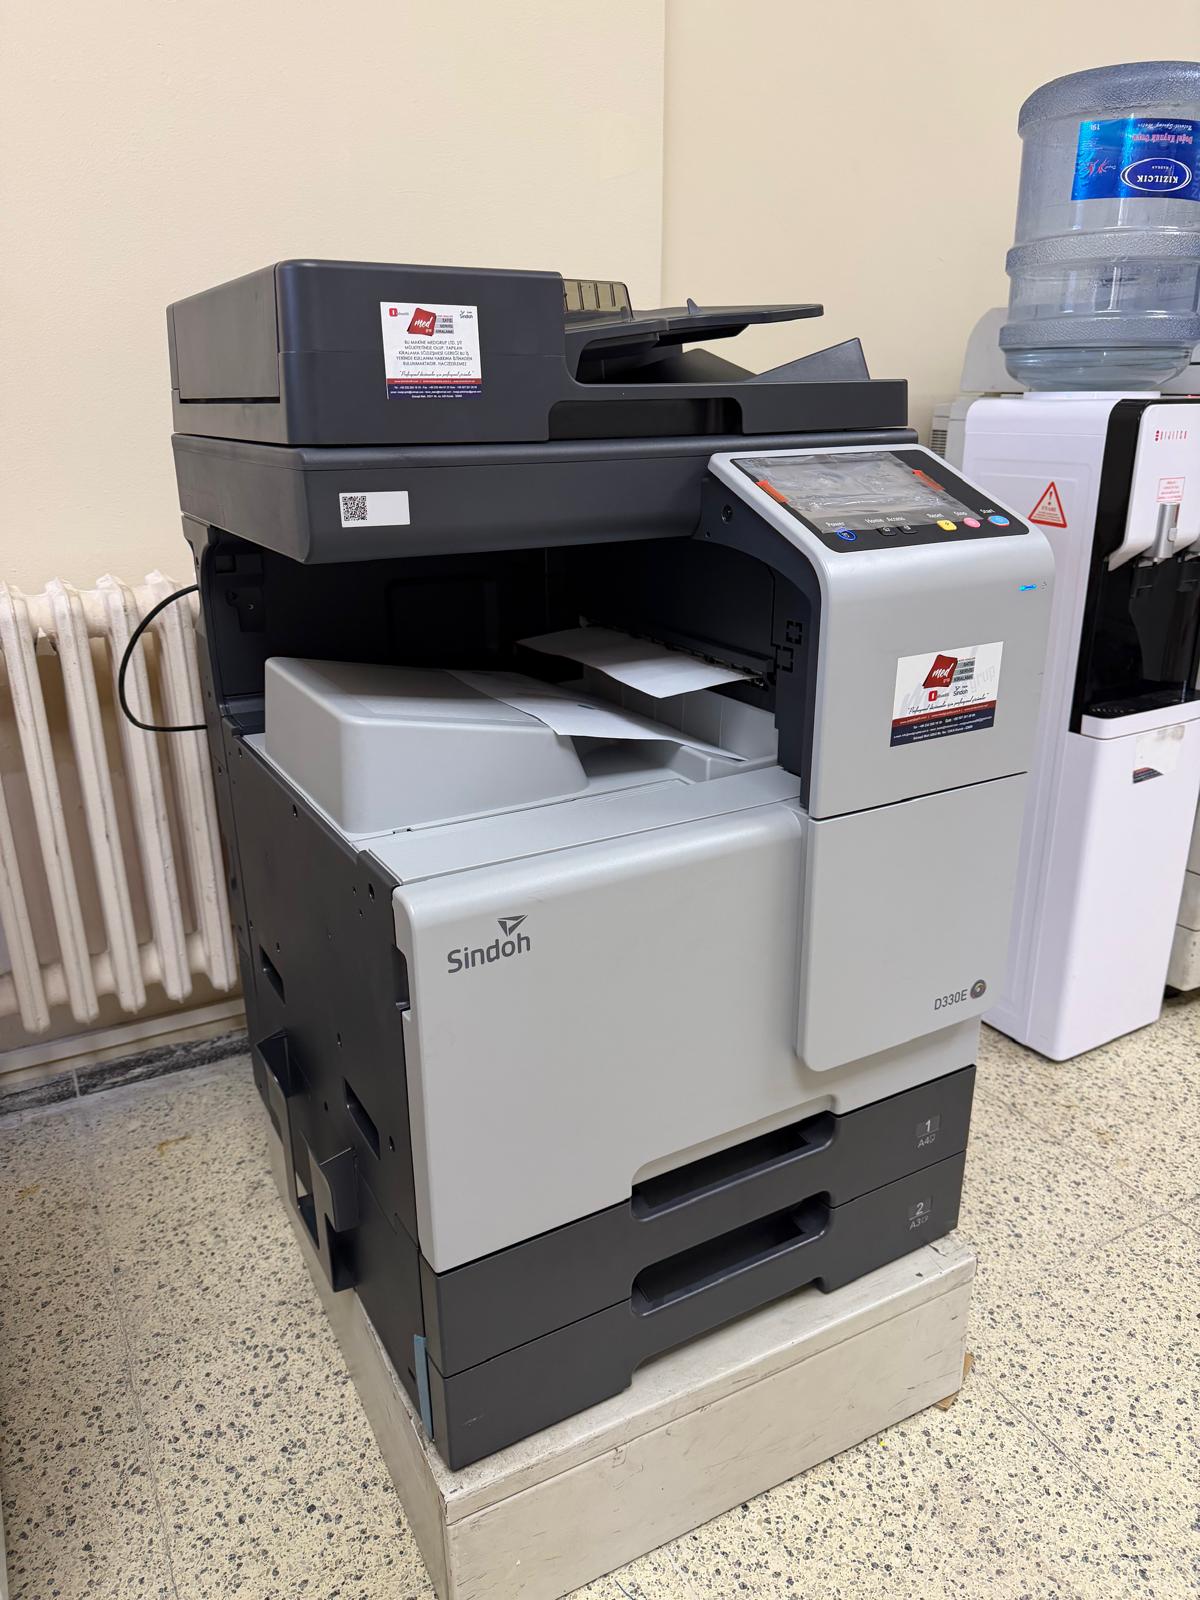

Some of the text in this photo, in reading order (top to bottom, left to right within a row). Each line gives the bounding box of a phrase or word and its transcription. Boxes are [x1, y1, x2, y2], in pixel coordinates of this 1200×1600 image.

[1137, 175, 1178, 184] KIZILCIK
[413, 316, 433, 329] med
[931, 662, 954, 678] med
[447, 933, 530, 974] Sindoh
[934, 989, 968, 1011] D330E
[925, 1119, 931, 1132] 1
[916, 1202, 924, 1215] 2
